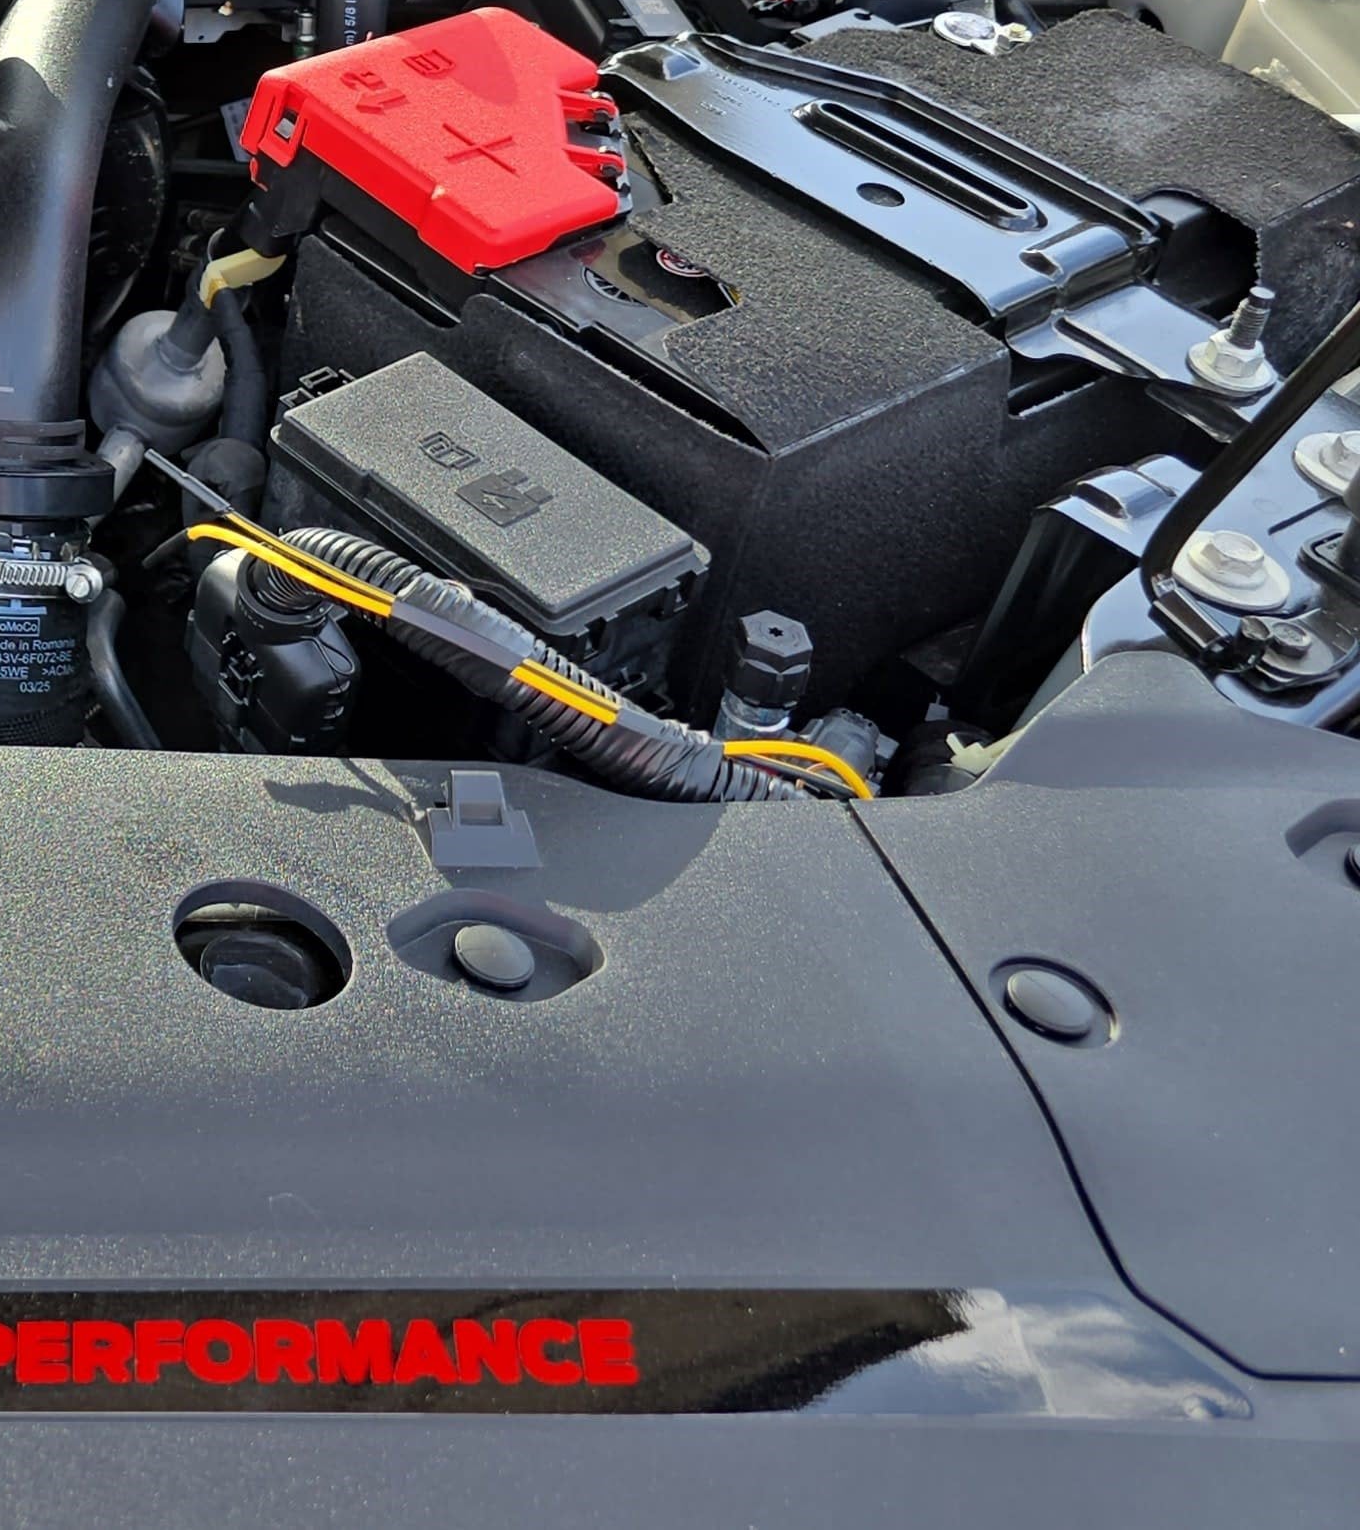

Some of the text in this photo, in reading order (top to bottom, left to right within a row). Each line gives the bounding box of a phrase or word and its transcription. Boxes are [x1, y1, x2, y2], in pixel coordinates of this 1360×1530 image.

[344, 6, 357, 27] 5/8
[19, 639, 30, 651] in
[19, 680, 52, 693] 03/25
